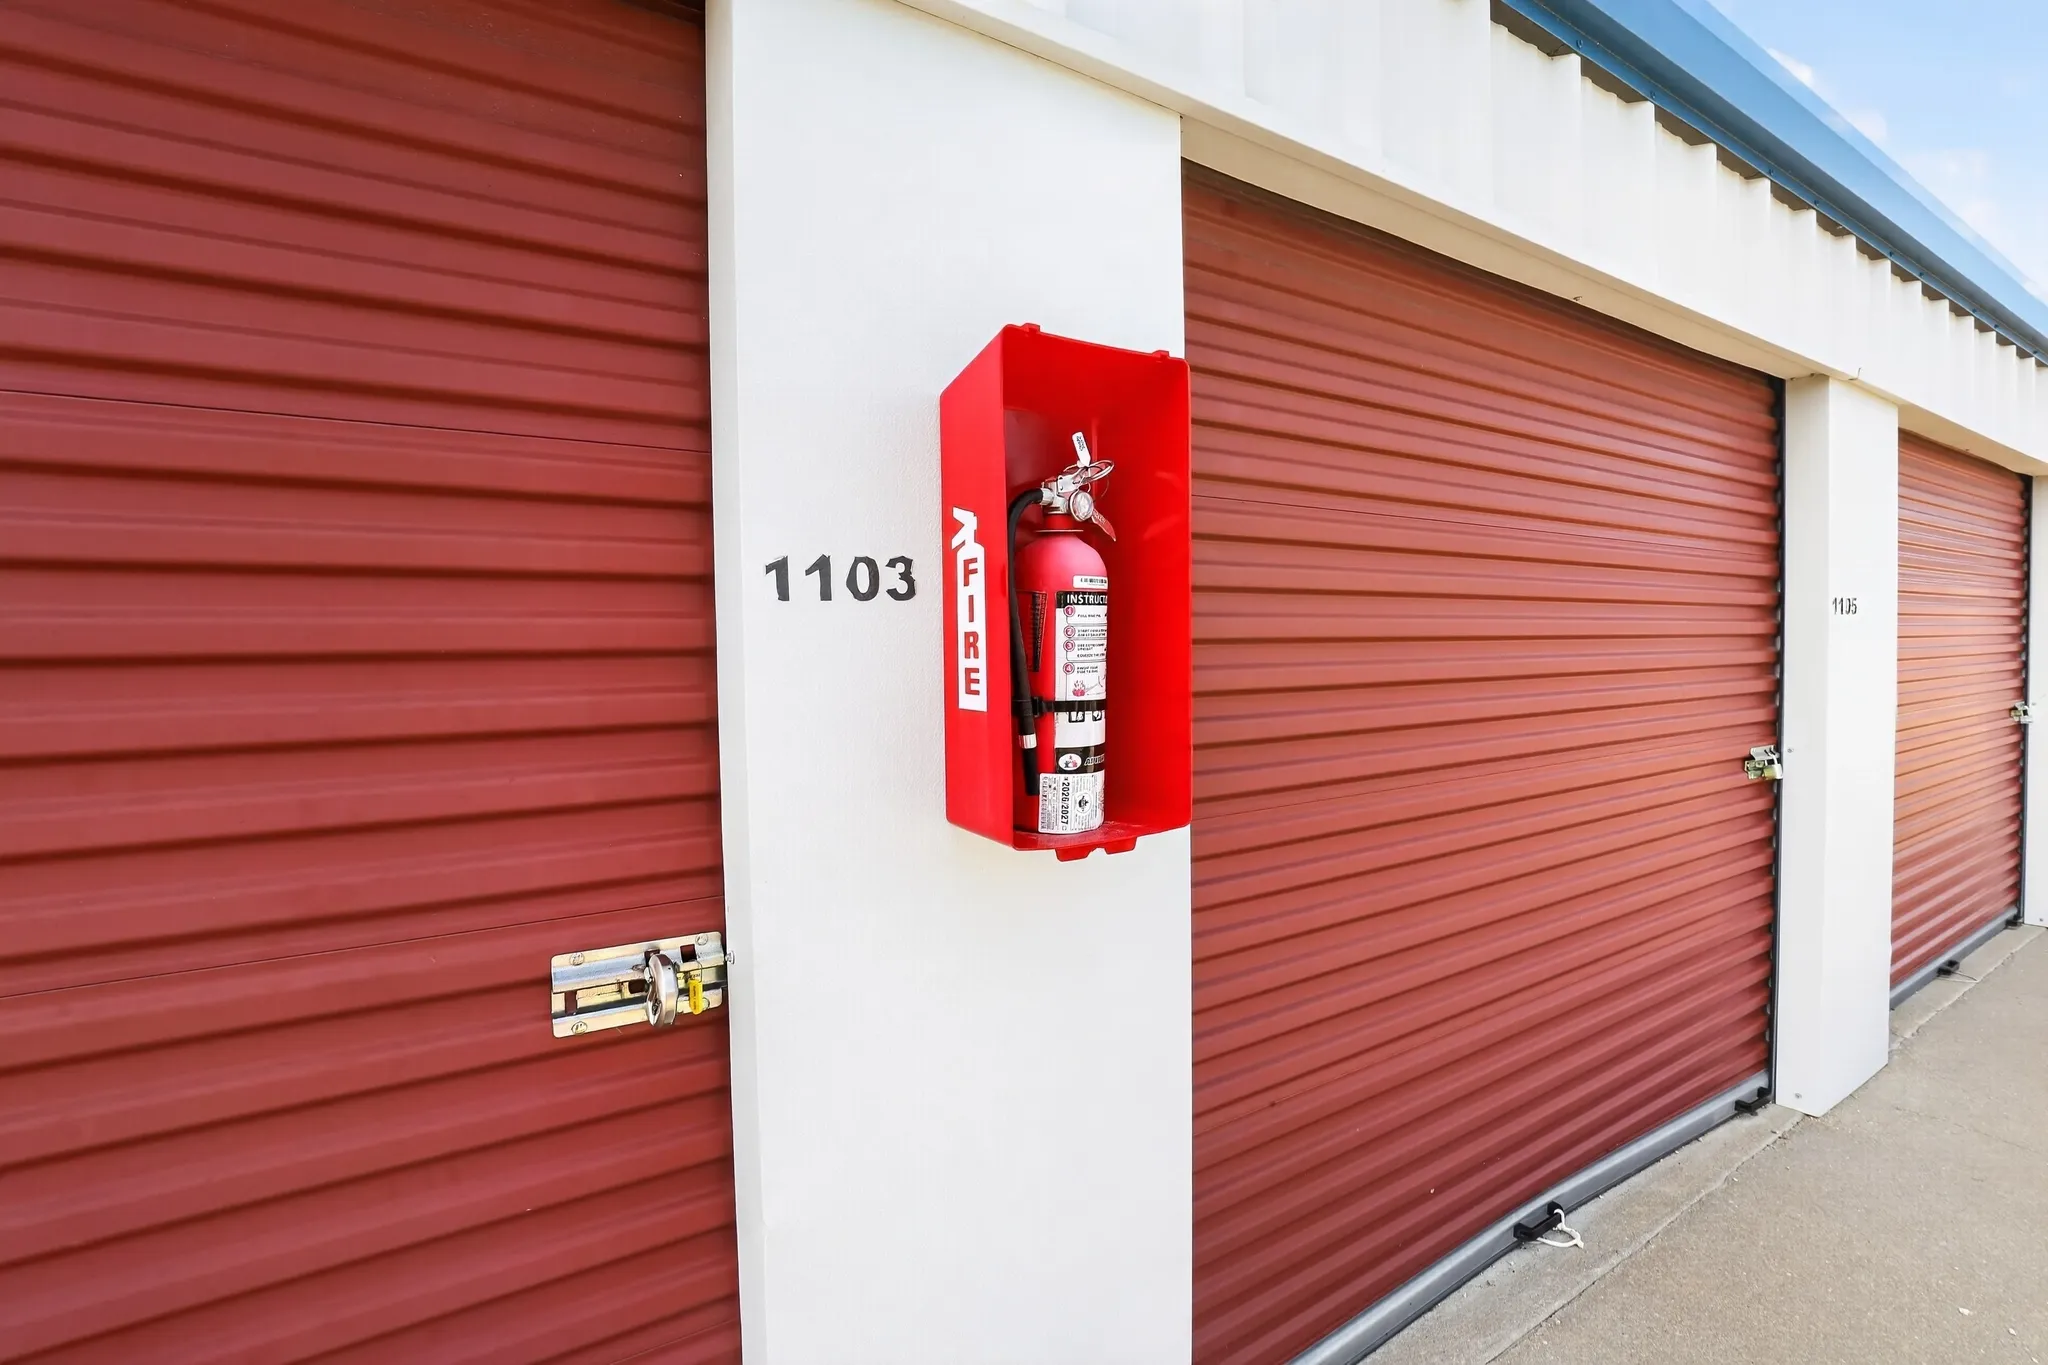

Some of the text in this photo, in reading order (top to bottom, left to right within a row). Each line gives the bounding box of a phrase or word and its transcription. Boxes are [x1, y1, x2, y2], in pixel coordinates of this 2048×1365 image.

[764, 554, 917, 602] 1103
[963, 557, 981, 696] FIRE
[1832, 597, 1857, 615] 1105
